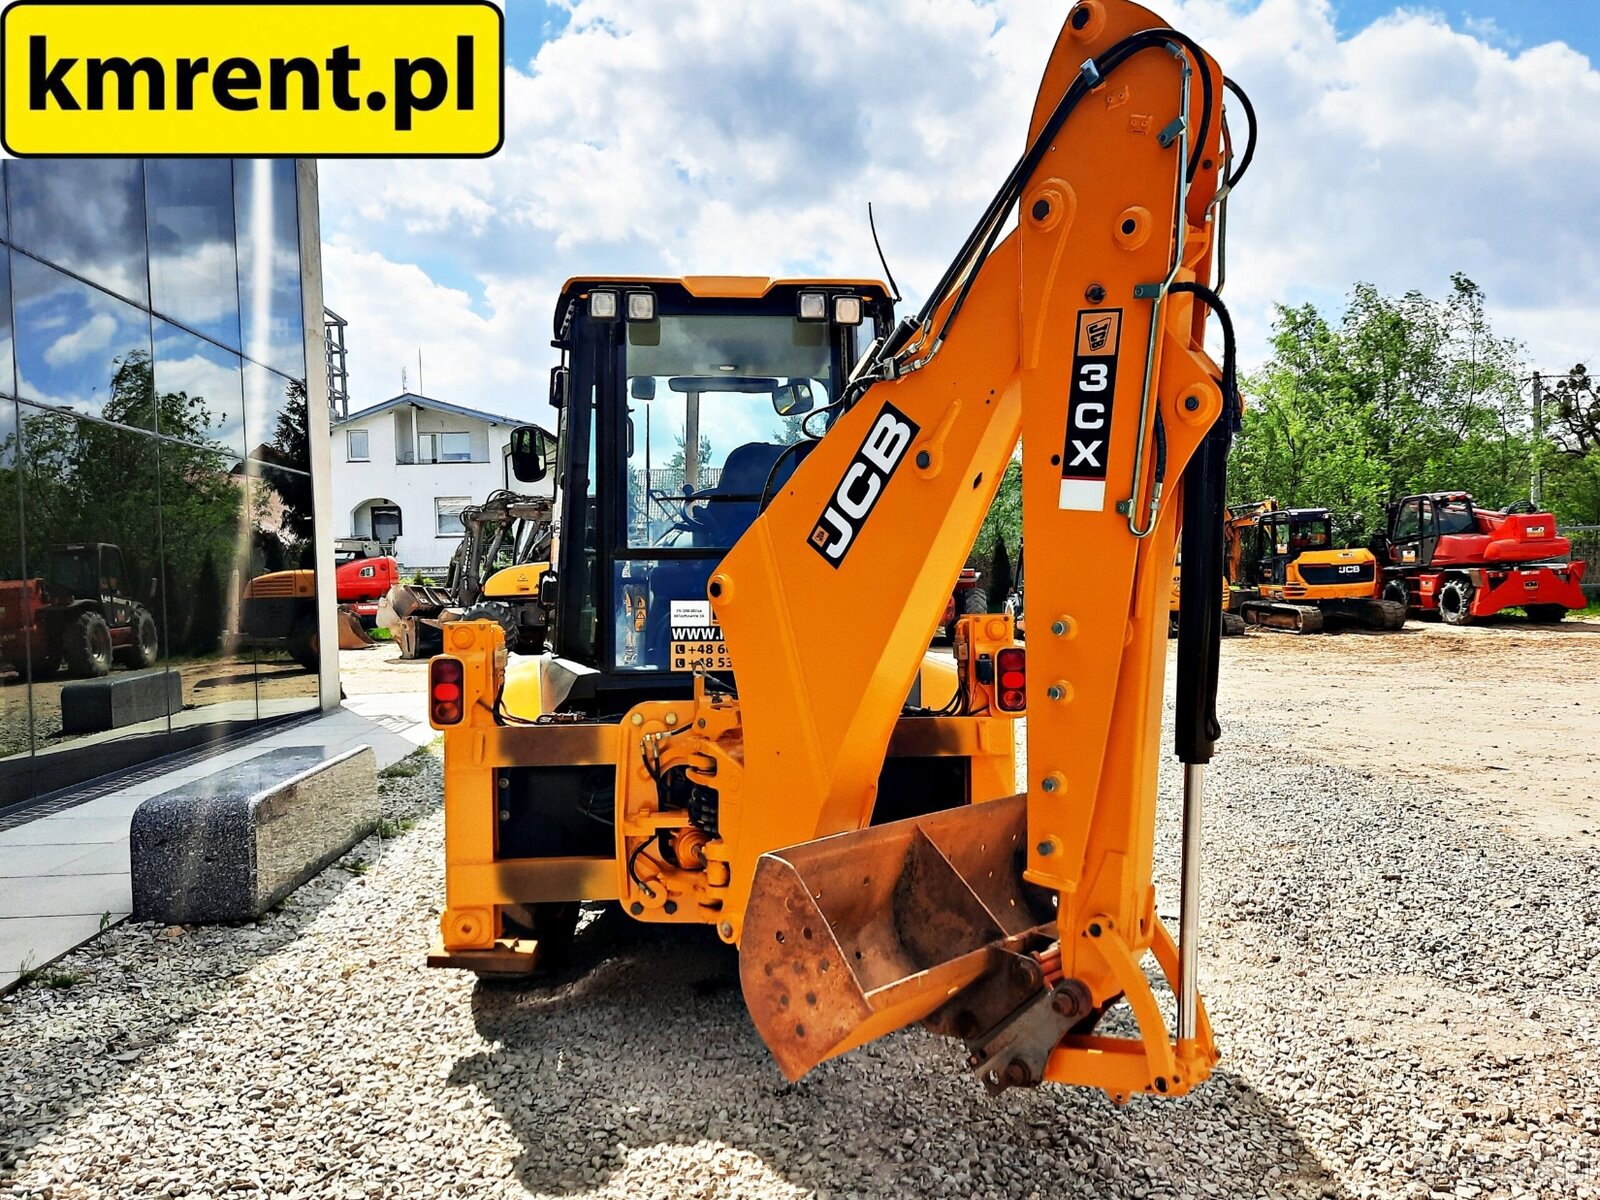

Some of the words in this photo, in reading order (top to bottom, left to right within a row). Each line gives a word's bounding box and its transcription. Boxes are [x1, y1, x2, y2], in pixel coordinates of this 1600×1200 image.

[824, 413, 911, 559] JCB
[1338, 565, 1360, 574] JCB
[688, 644, 714, 654] +48
